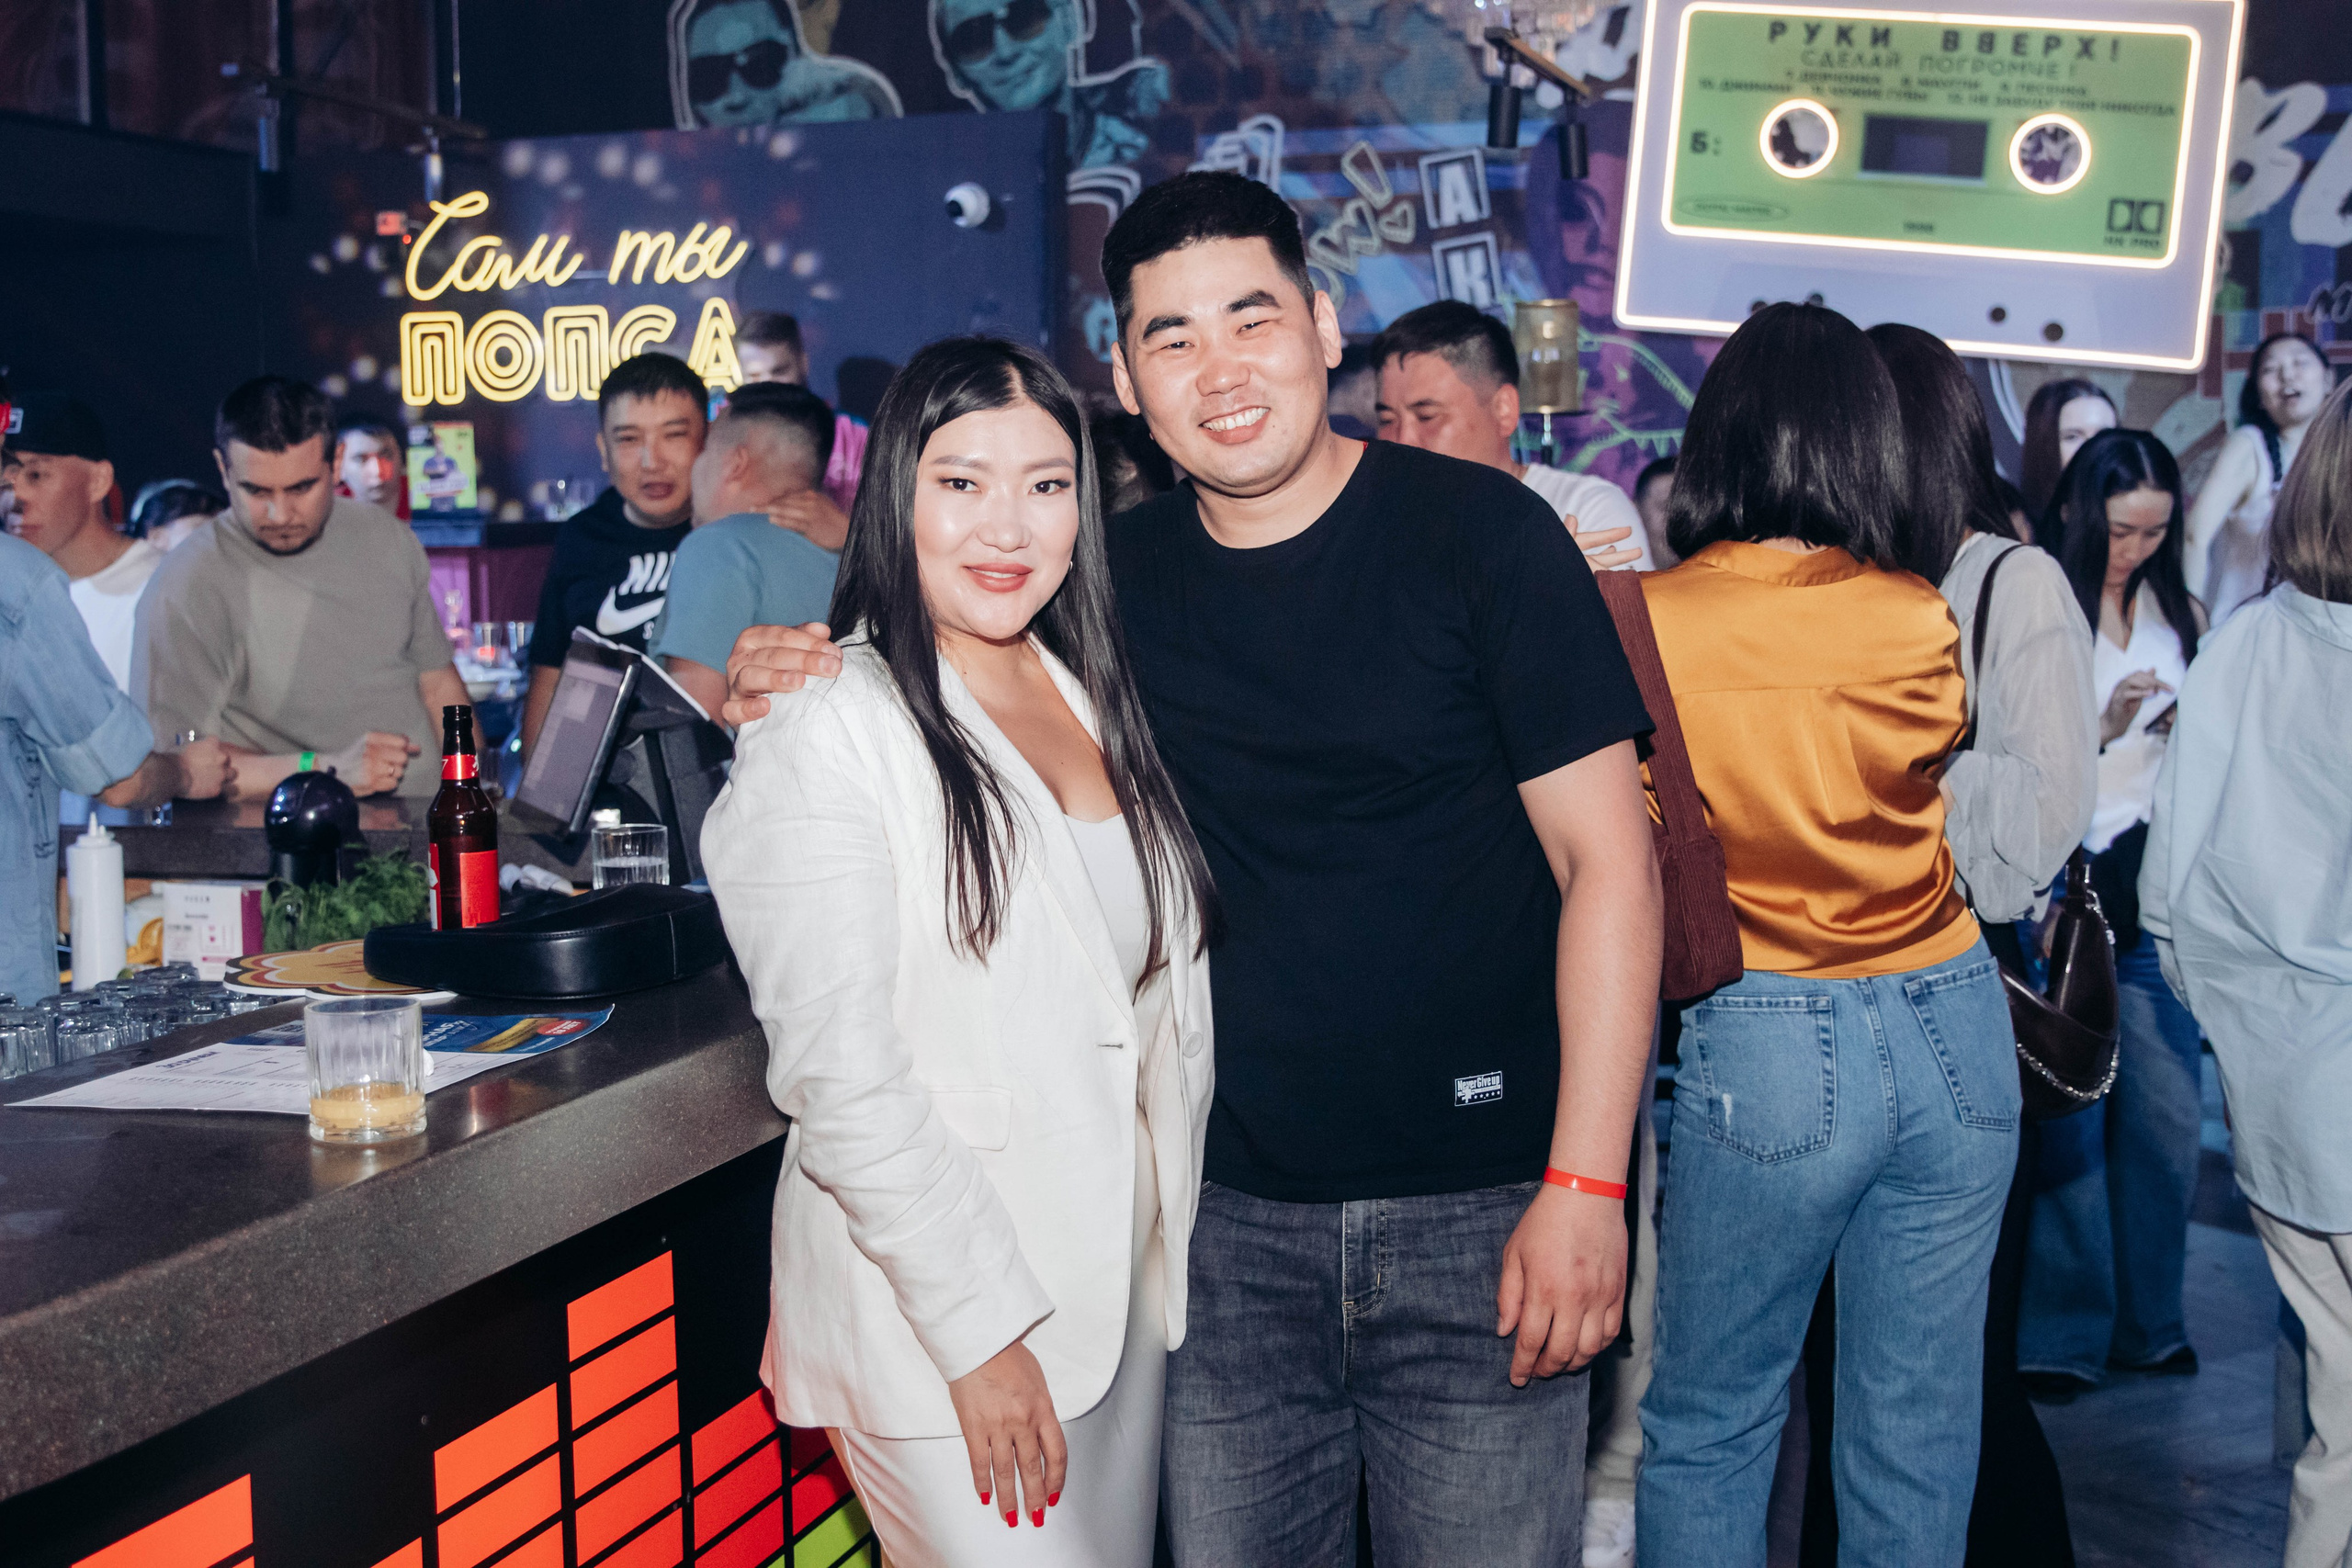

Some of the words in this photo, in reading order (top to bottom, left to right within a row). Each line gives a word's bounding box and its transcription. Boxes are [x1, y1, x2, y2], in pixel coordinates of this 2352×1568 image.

[1769, 20, 1891, 47] РУКИ
[1943, 28, 2119, 61] ВВЕРХ!
[1801, 49, 1901, 69] СДЕЛАЙ
[607, 222, 749, 286] ты
[1477, 1076, 1491, 1088] Give
[1492, 1076, 1500, 1085] up
